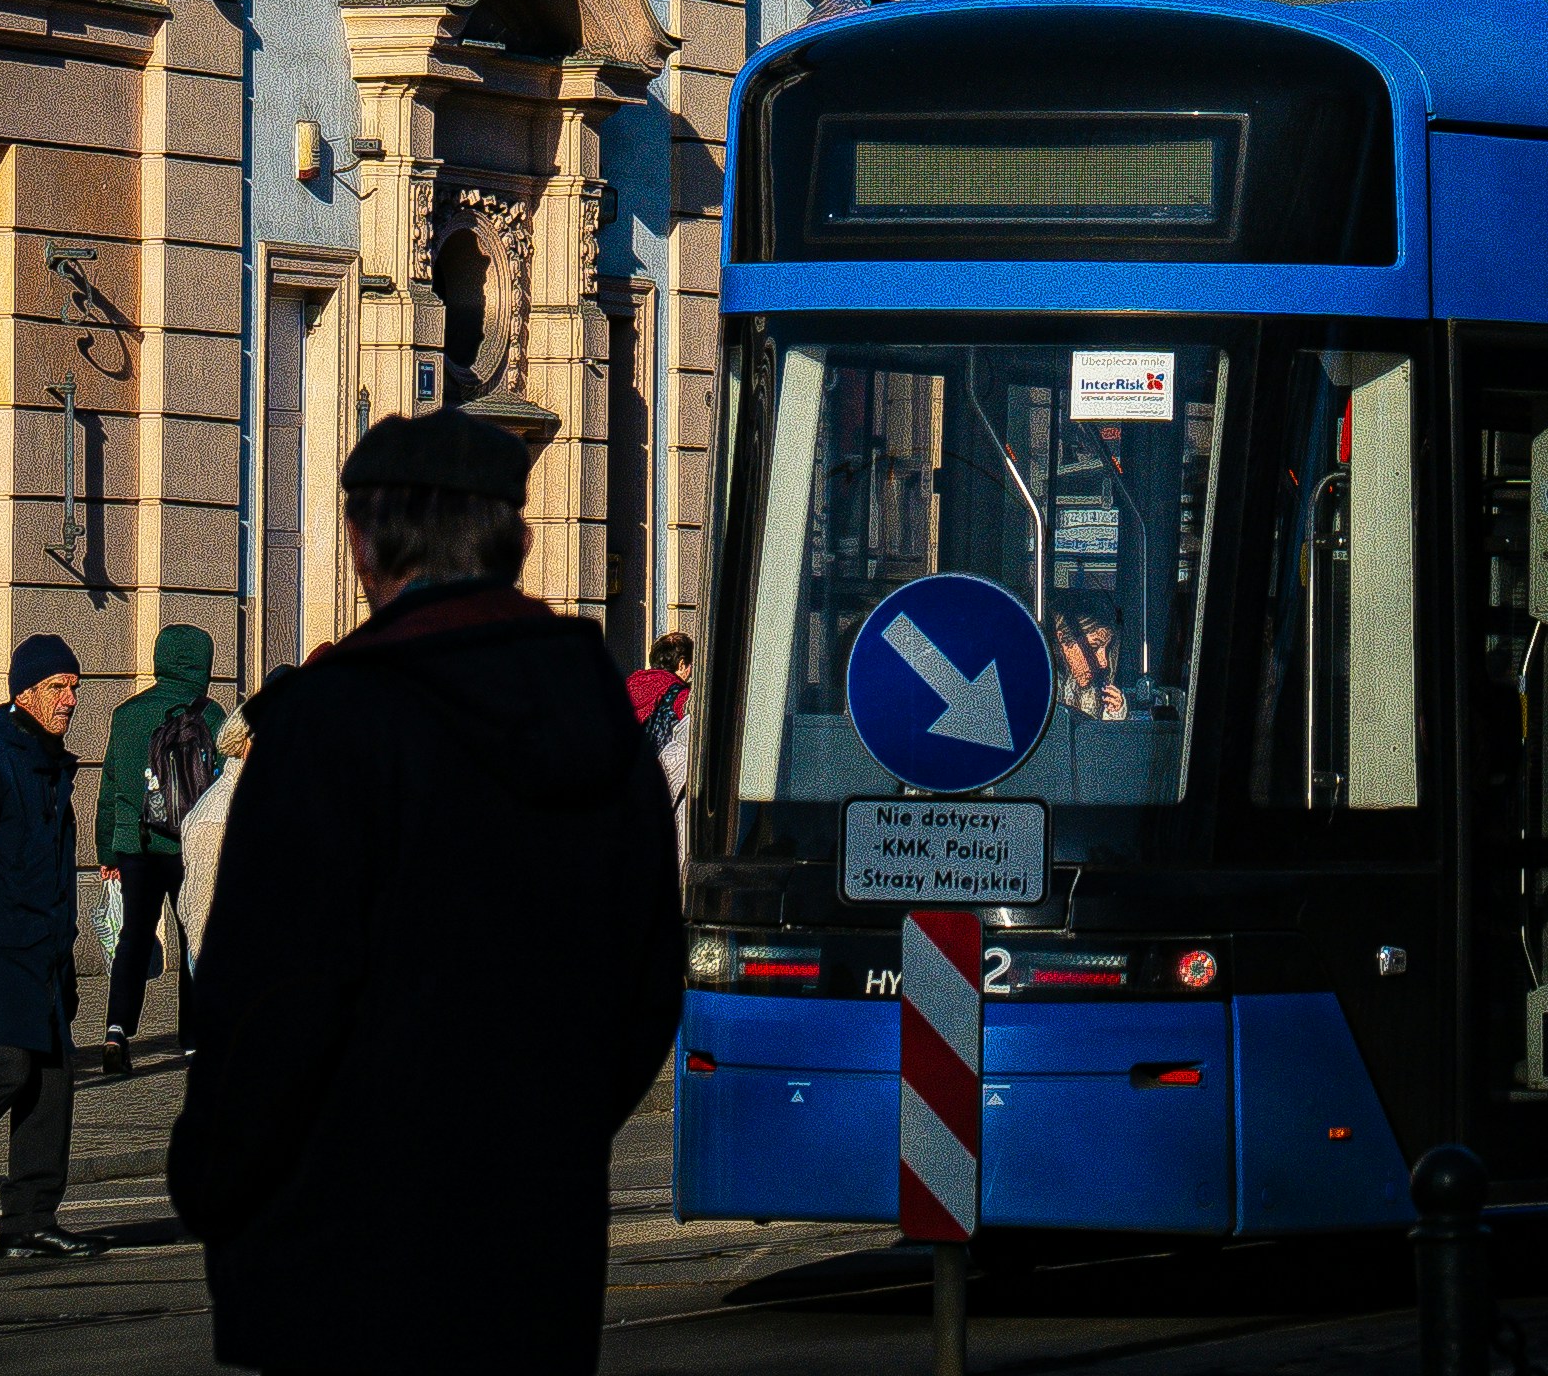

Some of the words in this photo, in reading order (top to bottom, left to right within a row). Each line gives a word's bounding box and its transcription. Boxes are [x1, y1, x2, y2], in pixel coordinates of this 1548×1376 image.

[1080, 378, 1145, 390] InterRisk
[876, 808, 913, 827] Nie
[945, 839, 1010, 864] Policji
[934, 870, 1028, 896] Miejskiej
